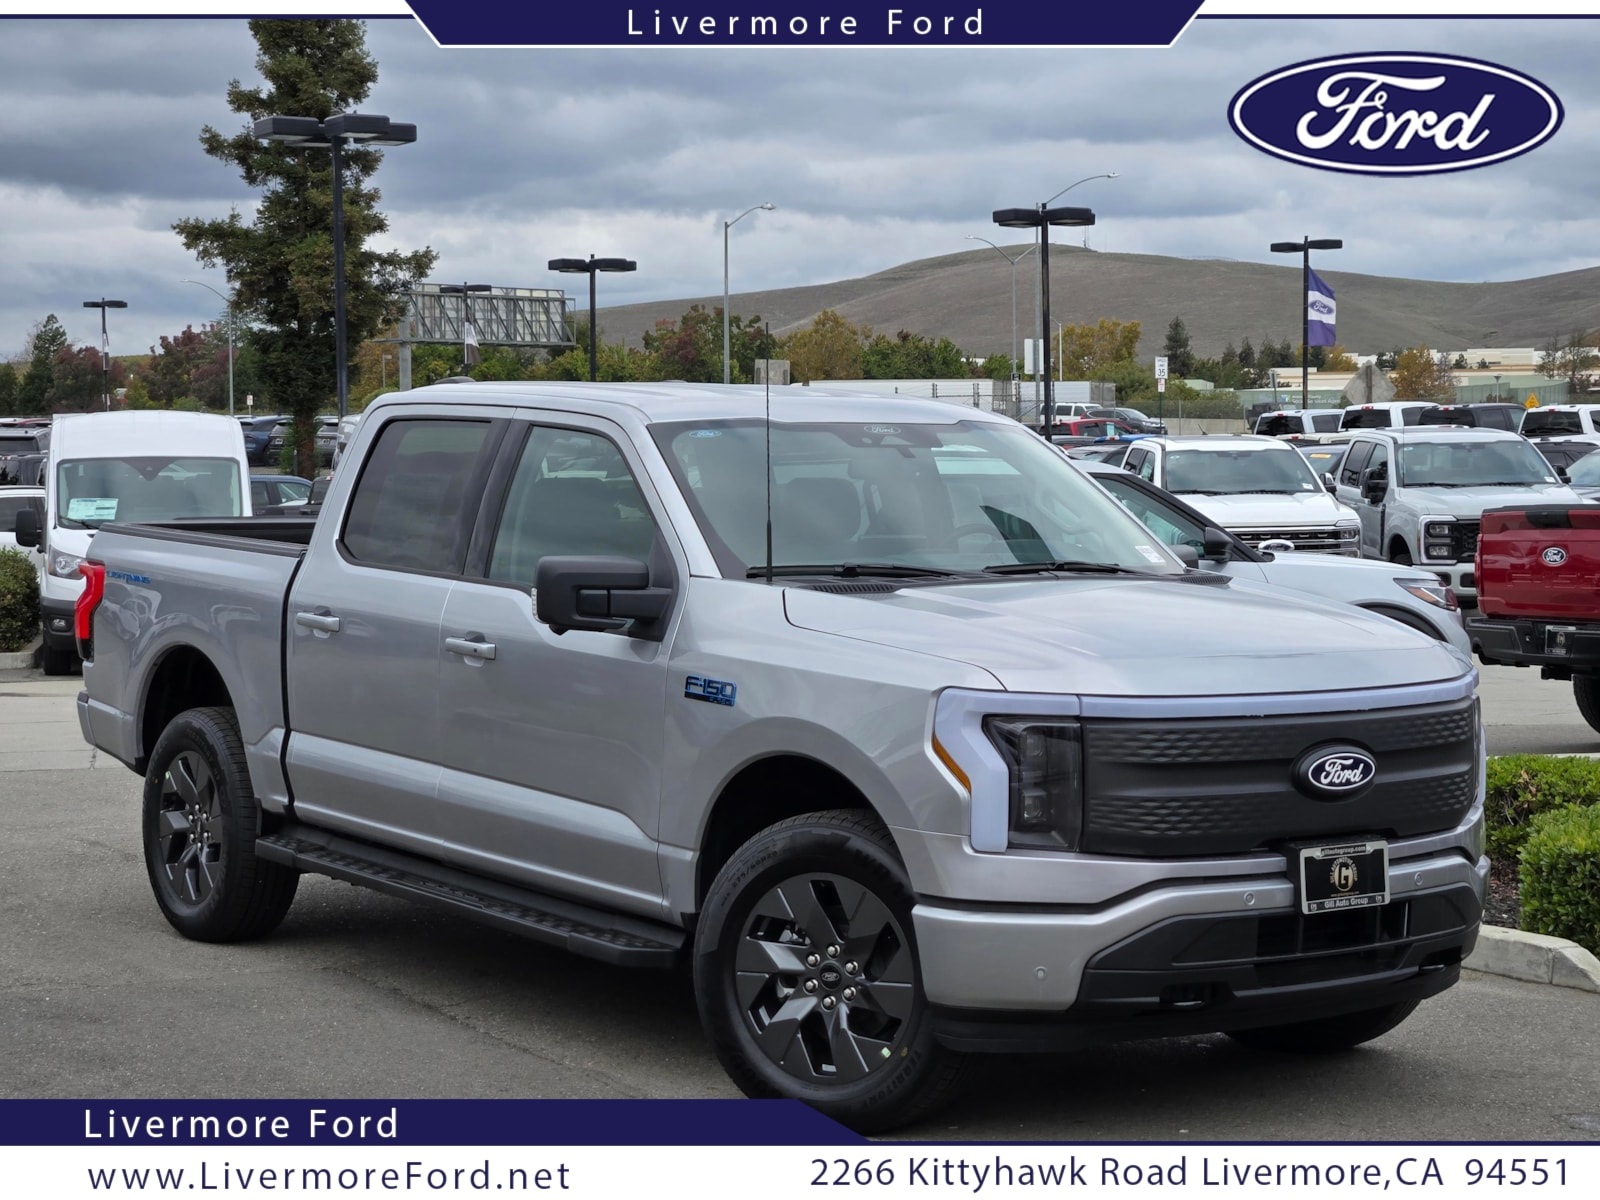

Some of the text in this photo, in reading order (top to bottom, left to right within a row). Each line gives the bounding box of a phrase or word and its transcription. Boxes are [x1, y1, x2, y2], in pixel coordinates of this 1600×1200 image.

[1157, 368, 1166, 377] 35
[1320, 758, 1365, 784] Ford
[1324, 896, 1369, 908] Gill Auto Group
